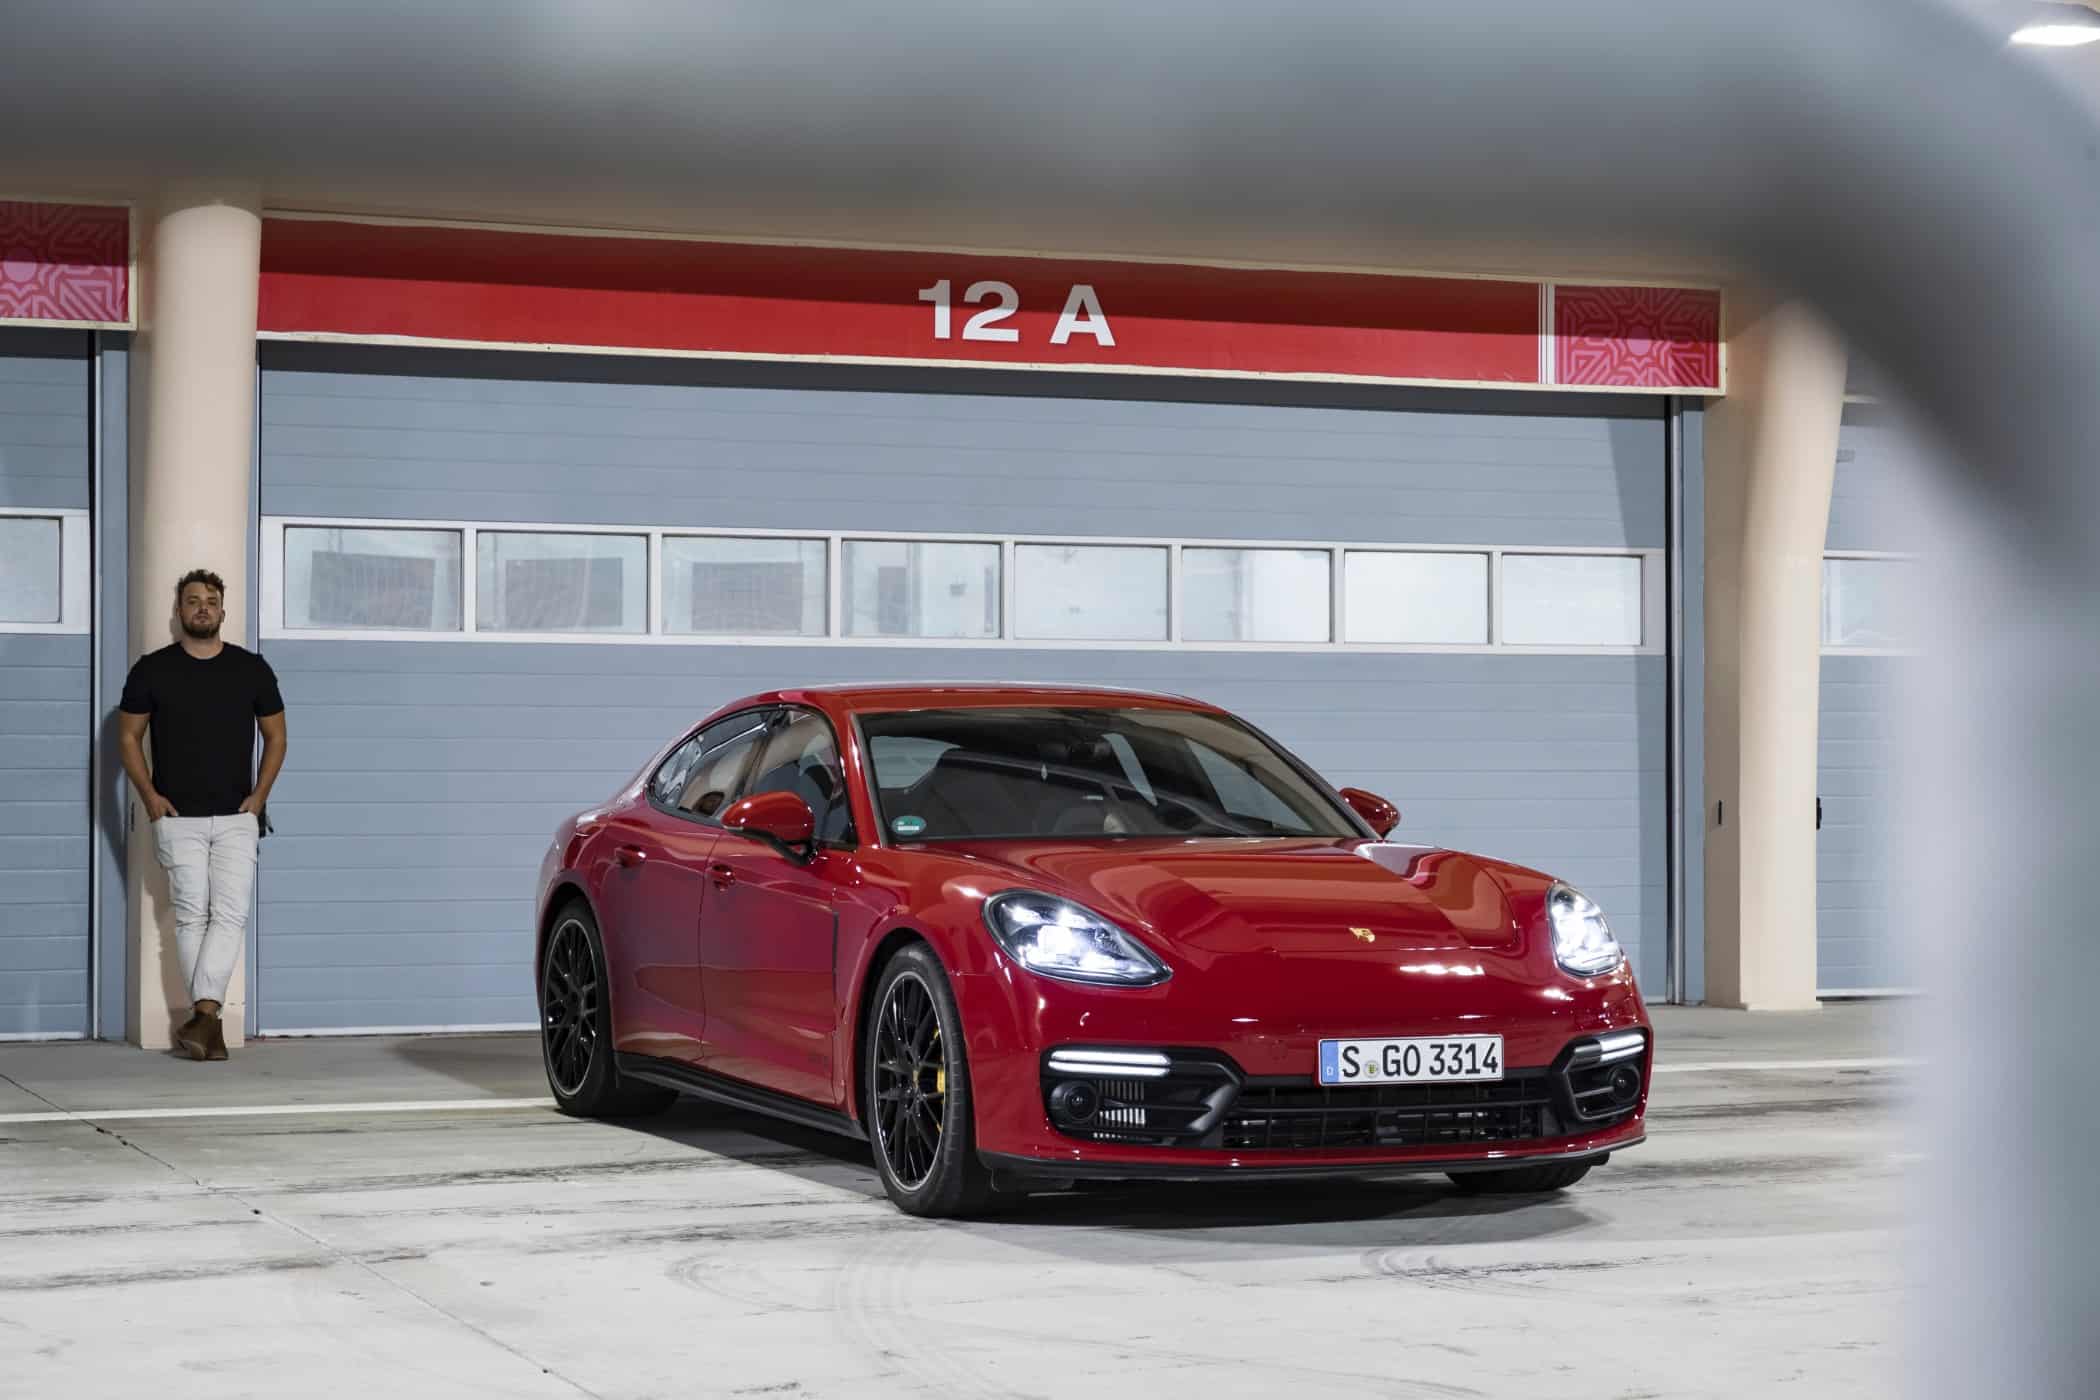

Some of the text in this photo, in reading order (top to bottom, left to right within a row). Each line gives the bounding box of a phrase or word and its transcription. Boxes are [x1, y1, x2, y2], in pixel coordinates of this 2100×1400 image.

[918, 279, 1116, 346] 12 A
[1342, 1042, 1498, 1078] S GO 3314
